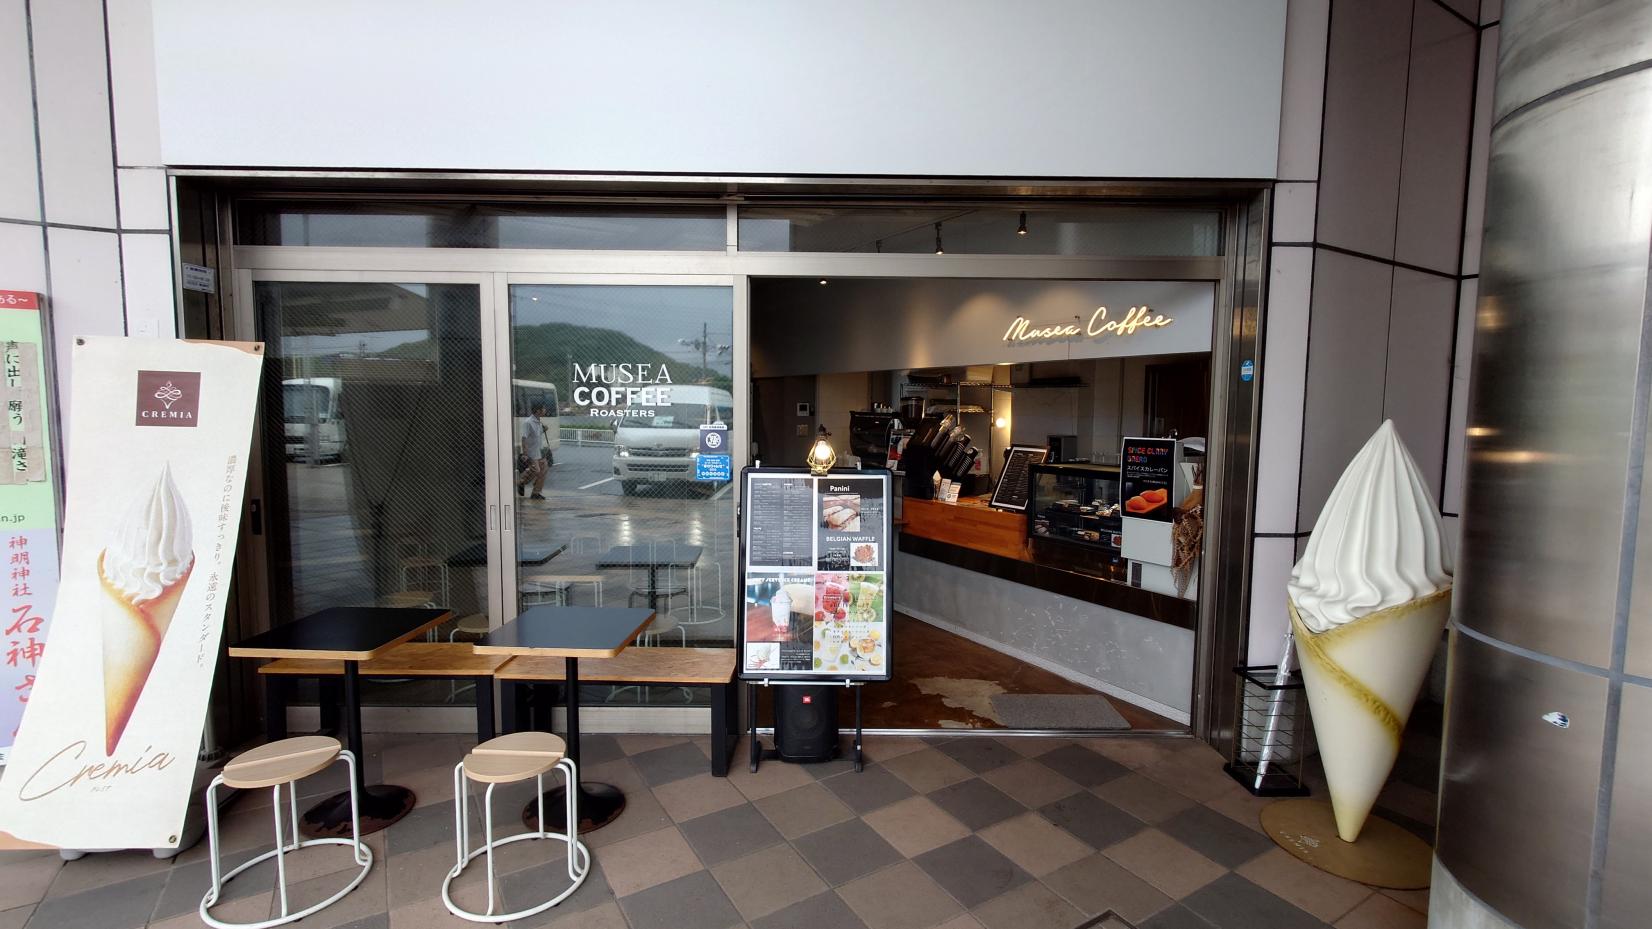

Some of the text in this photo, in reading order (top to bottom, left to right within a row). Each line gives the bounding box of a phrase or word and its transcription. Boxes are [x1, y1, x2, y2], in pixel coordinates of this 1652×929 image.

[1002, 306, 1173, 341] Musea Coffee
[572, 363, 673, 384] MUSEA
[573, 386, 672, 406] COFFEE
[142, 410, 193, 419] CREMIA
[1127, 465, 1169, 473] スパイスカレーパン
[9, 536, 32, 597] 神明神社
[18, 740, 175, 801] Cremia
